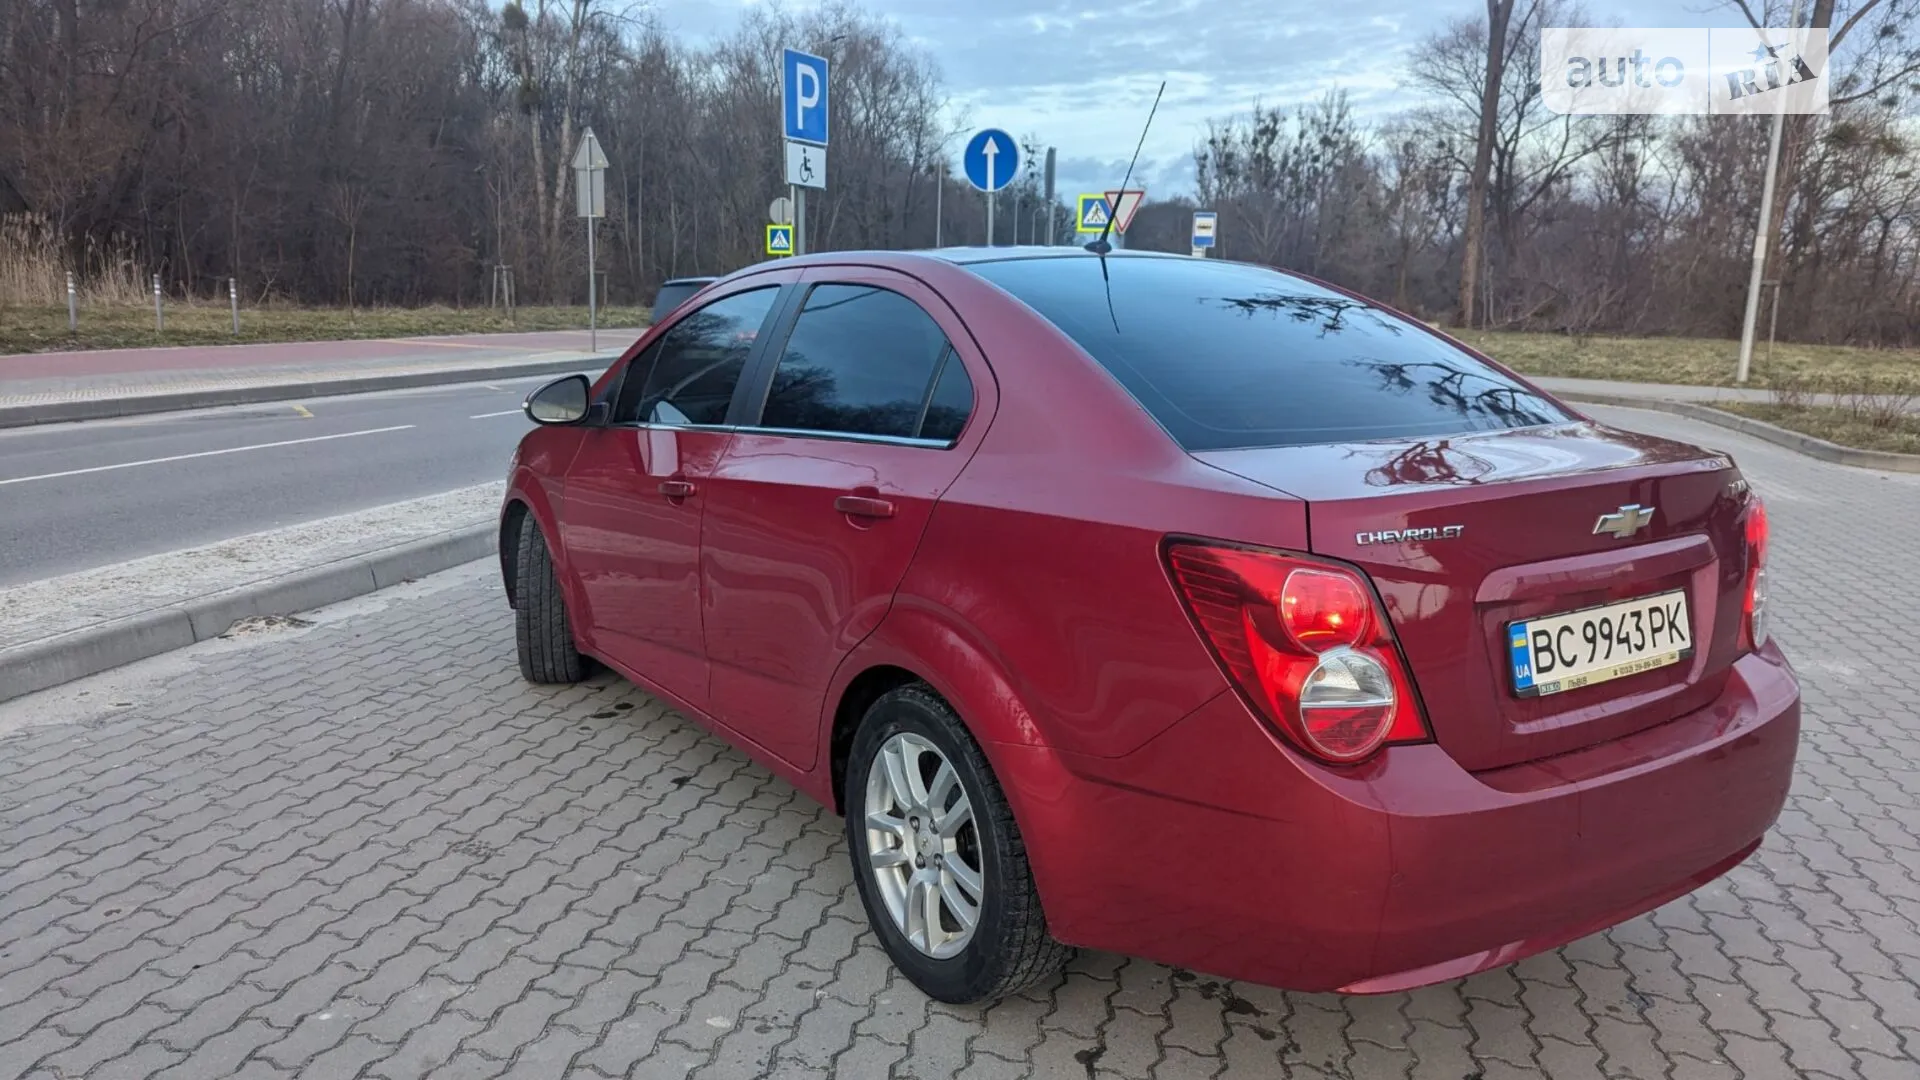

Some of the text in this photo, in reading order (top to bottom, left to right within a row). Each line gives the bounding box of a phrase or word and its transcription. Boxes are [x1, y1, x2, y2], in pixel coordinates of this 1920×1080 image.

[796, 62, 820, 130] P
[1355, 524, 1465, 545] CHEVROLET
[1531, 601, 1686, 675] BC 9943 PK
[1515, 664, 1531, 679] UA
